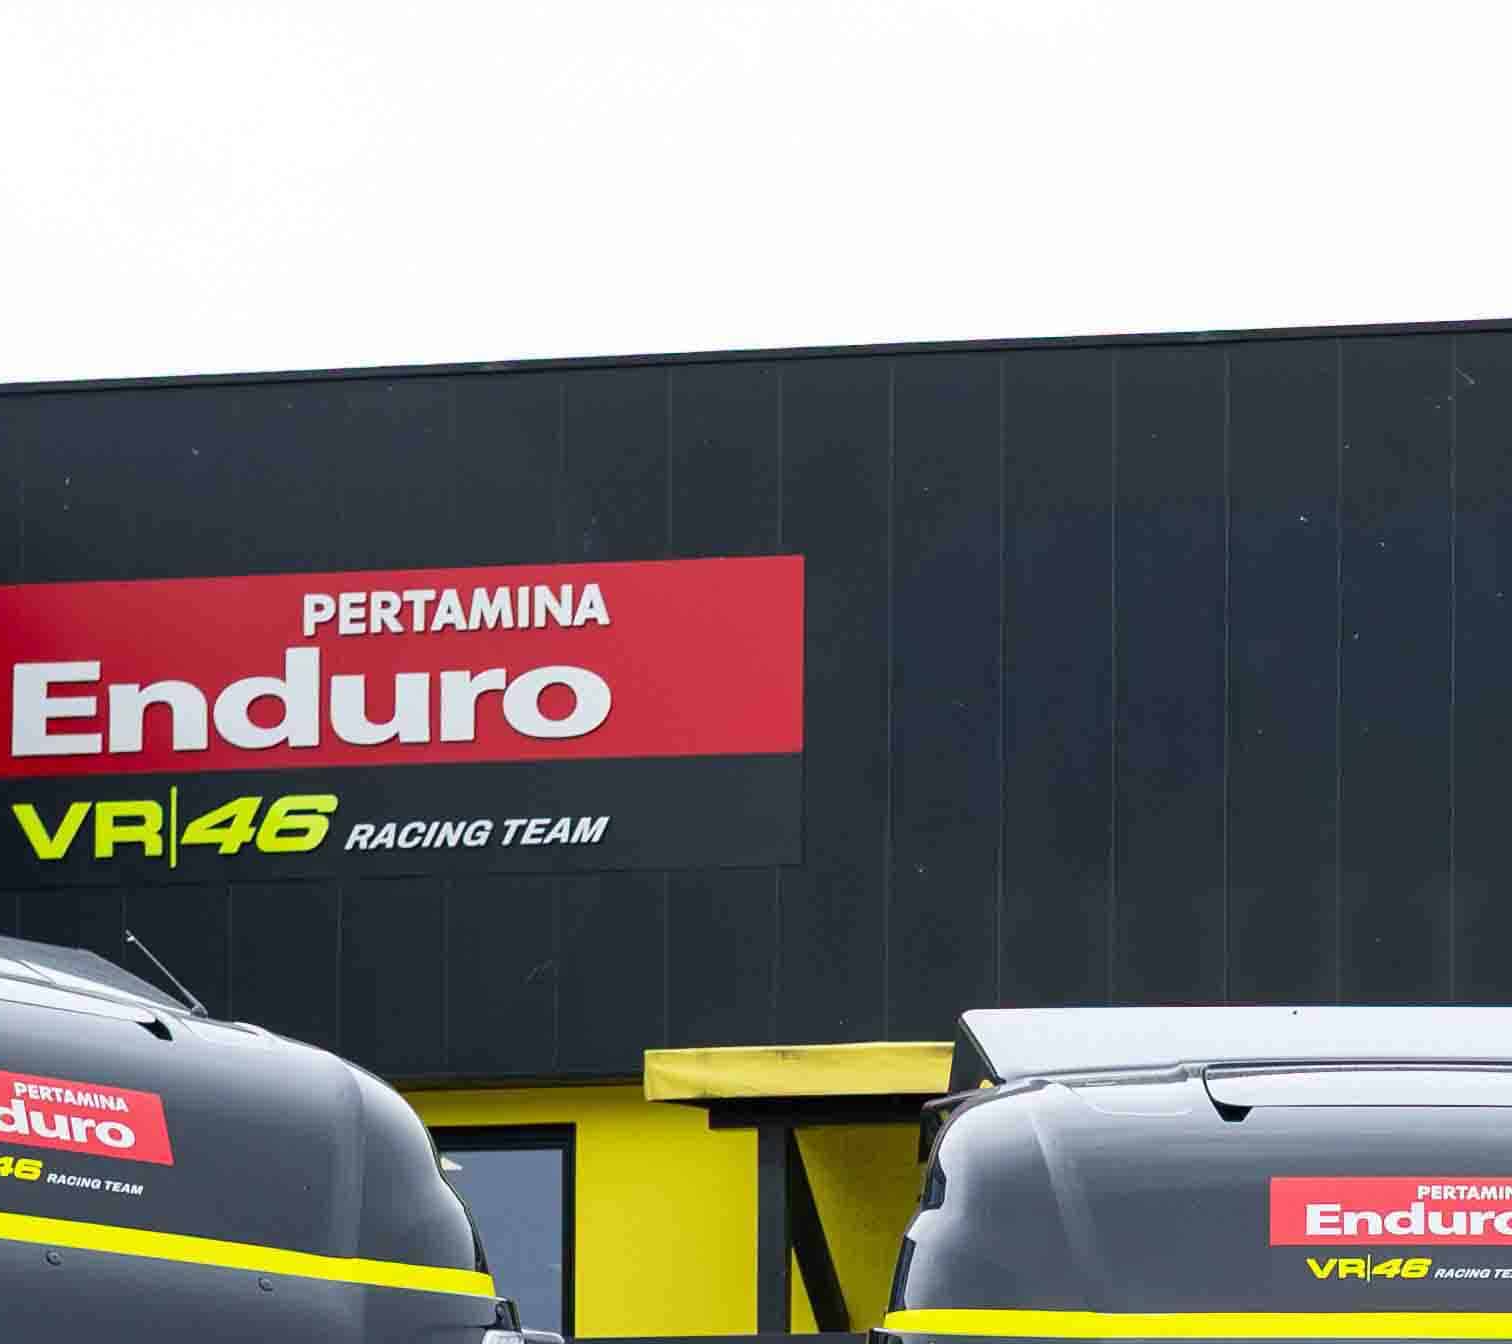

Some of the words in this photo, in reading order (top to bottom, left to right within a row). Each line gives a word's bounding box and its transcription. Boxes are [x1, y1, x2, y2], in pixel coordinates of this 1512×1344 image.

[302, 582, 611, 638] PERTAMINA
[10, 647, 613, 758] Enduro
[344, 819, 497, 851] RACING
[500, 815, 610, 847] TEAM
[13, 1081, 129, 1112] PERTAMINA
[47, 1173, 101, 1190] RACING
[104, 1179, 144, 1195] TEAM
[1434, 1268, 1490, 1279] RACING
